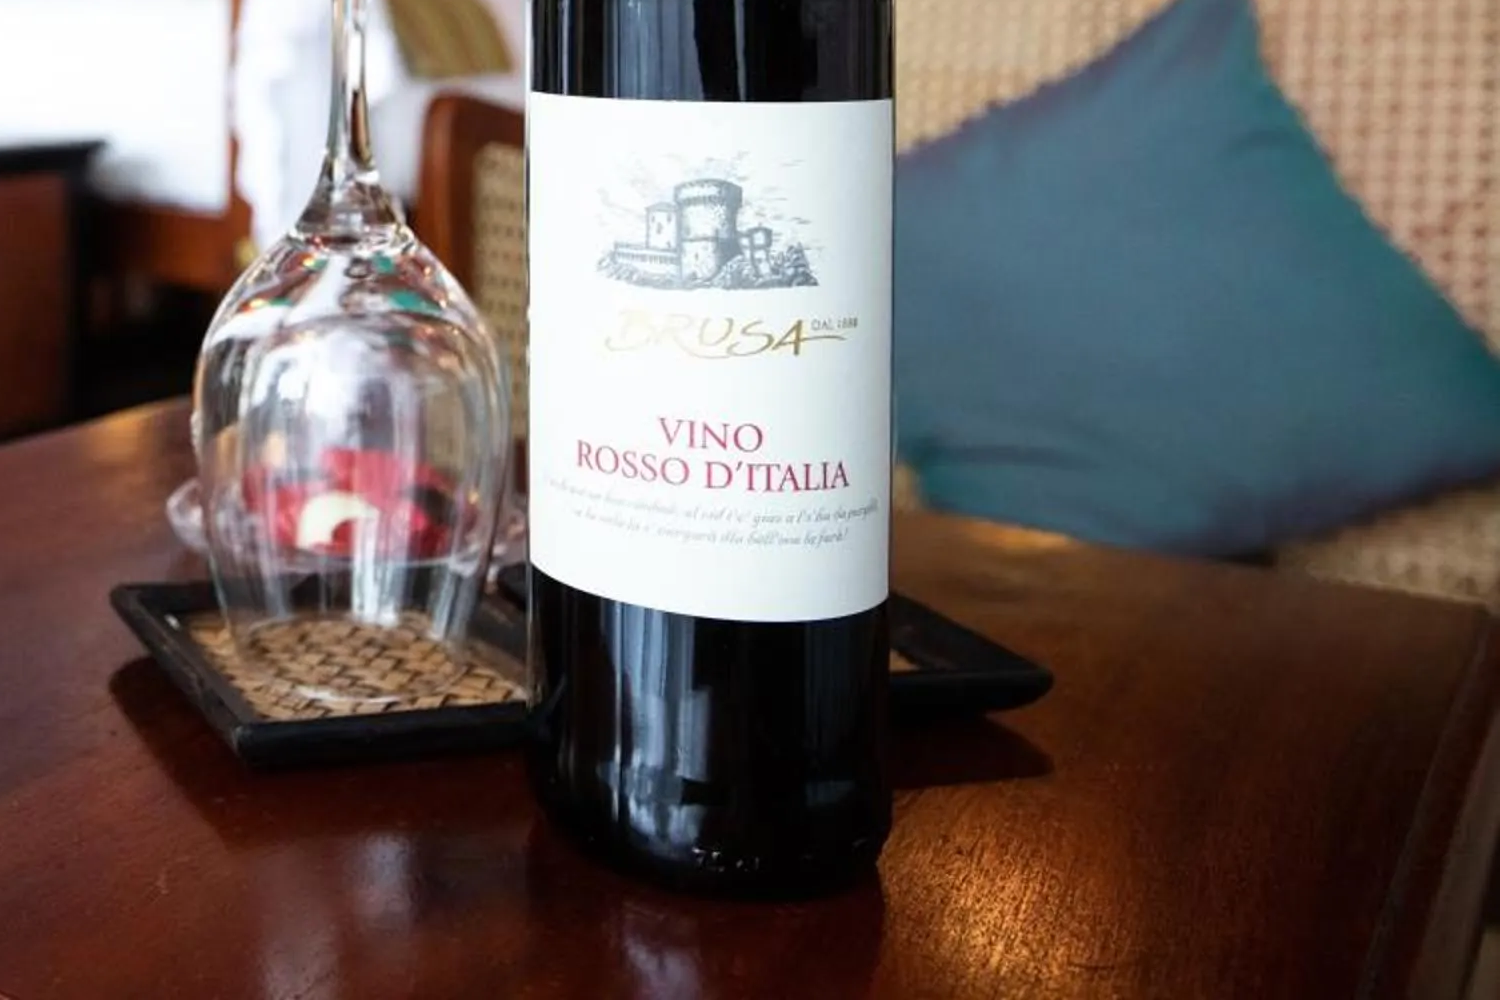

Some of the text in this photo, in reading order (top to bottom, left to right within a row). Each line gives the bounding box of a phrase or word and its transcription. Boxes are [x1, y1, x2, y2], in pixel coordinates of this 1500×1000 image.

[603, 308, 848, 359] BRUSA
[658, 417, 764, 453] VINO
[575, 438, 851, 494] ROSSO D'ITALIA
